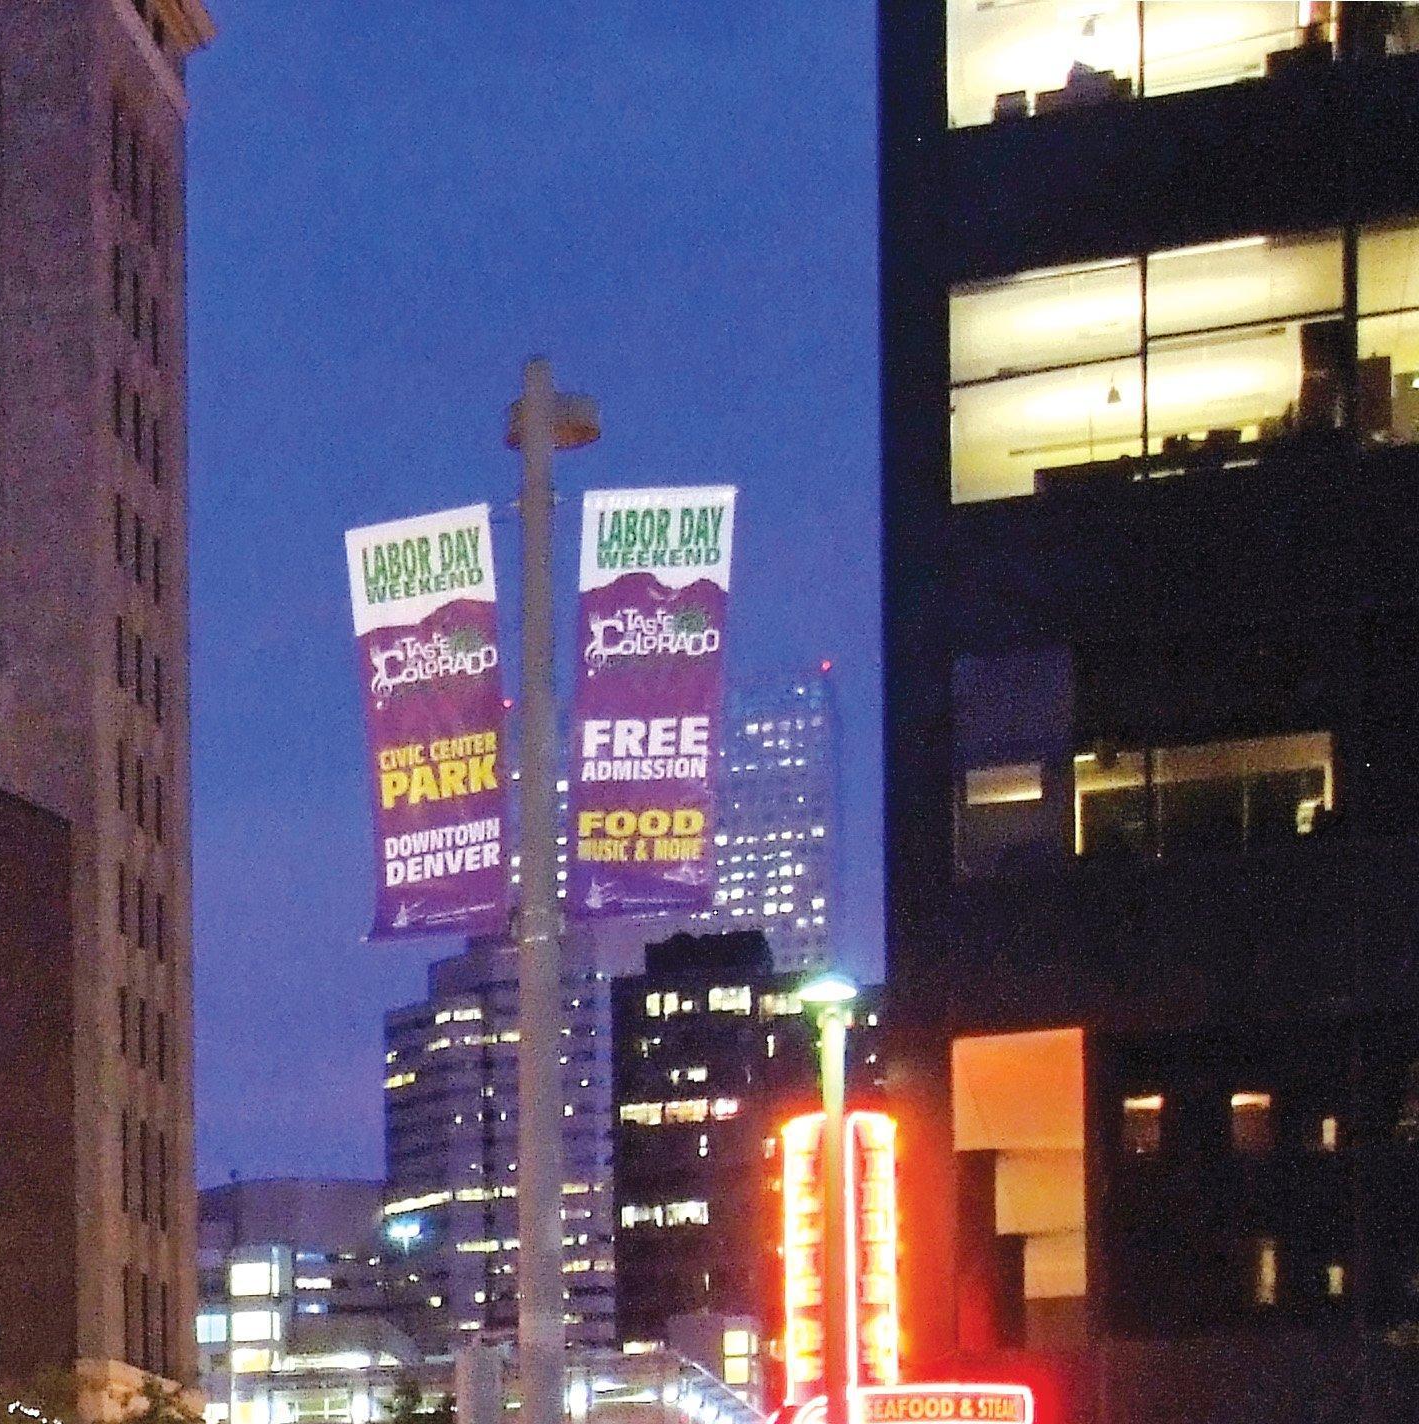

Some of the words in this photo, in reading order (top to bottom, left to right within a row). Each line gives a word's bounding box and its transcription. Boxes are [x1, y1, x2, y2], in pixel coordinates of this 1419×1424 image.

[597, 509, 671, 549] LABOR
[680, 505, 724, 547] DAY
[362, 537, 432, 582] LABOR
[438, 526, 480, 571] DAY
[597, 548, 720, 570] WEEKEND
[365, 567, 484, 605] WEEKEND
[379, 744, 425, 771] CIVIC
[430, 731, 498, 761] CENTER
[581, 716, 710, 758] FREE
[381, 754, 499, 809] PARK
[581, 757, 707, 782] ADMISSION
[384, 817, 501, 860] DOWNTOWN
[578, 808, 705, 838] FOOD
[385, 841, 501, 887] DENVER
[634, 839, 649, 862] &
[864, 1398, 953, 1420] SEAFOOD
[959, 1398, 973, 1418] &
